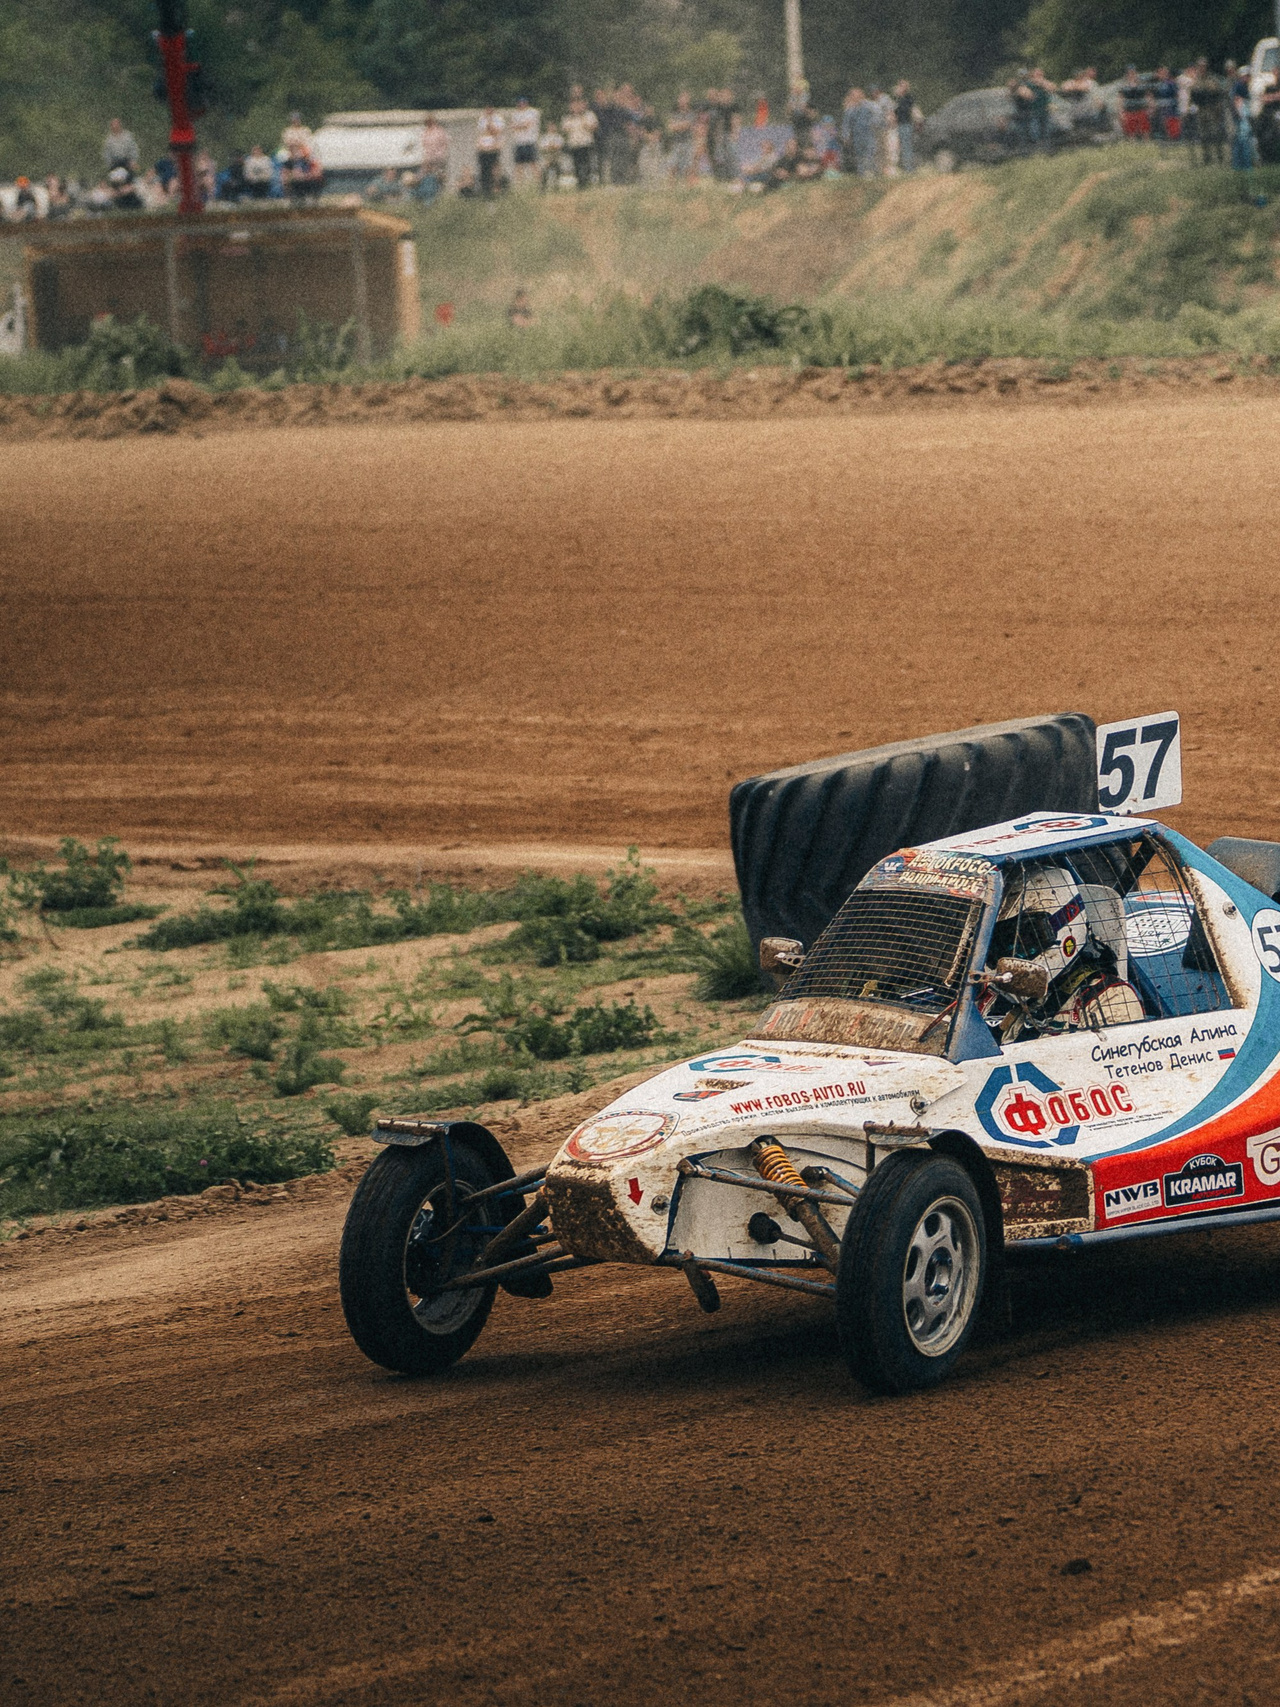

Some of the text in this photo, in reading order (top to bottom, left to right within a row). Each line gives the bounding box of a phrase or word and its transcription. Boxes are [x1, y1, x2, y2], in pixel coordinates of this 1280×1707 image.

[1099, 719, 1179, 809] 57
[1091, 1024, 1238, 1062] Синегубская Алина
[1104, 1051, 1214, 1079] Тетенов Денис
[730, 1080, 867, 1115] WWW.FOBOS-AVTO.RU
[877, 1089, 921, 1102] автомобилям
[1004, 1084, 1134, 1136] ФОБОС
[1189, 1156, 1218, 1170] КУБОК
[1105, 1181, 1159, 1207] NWB
[1170, 1171, 1237, 1197] KRAMAR
